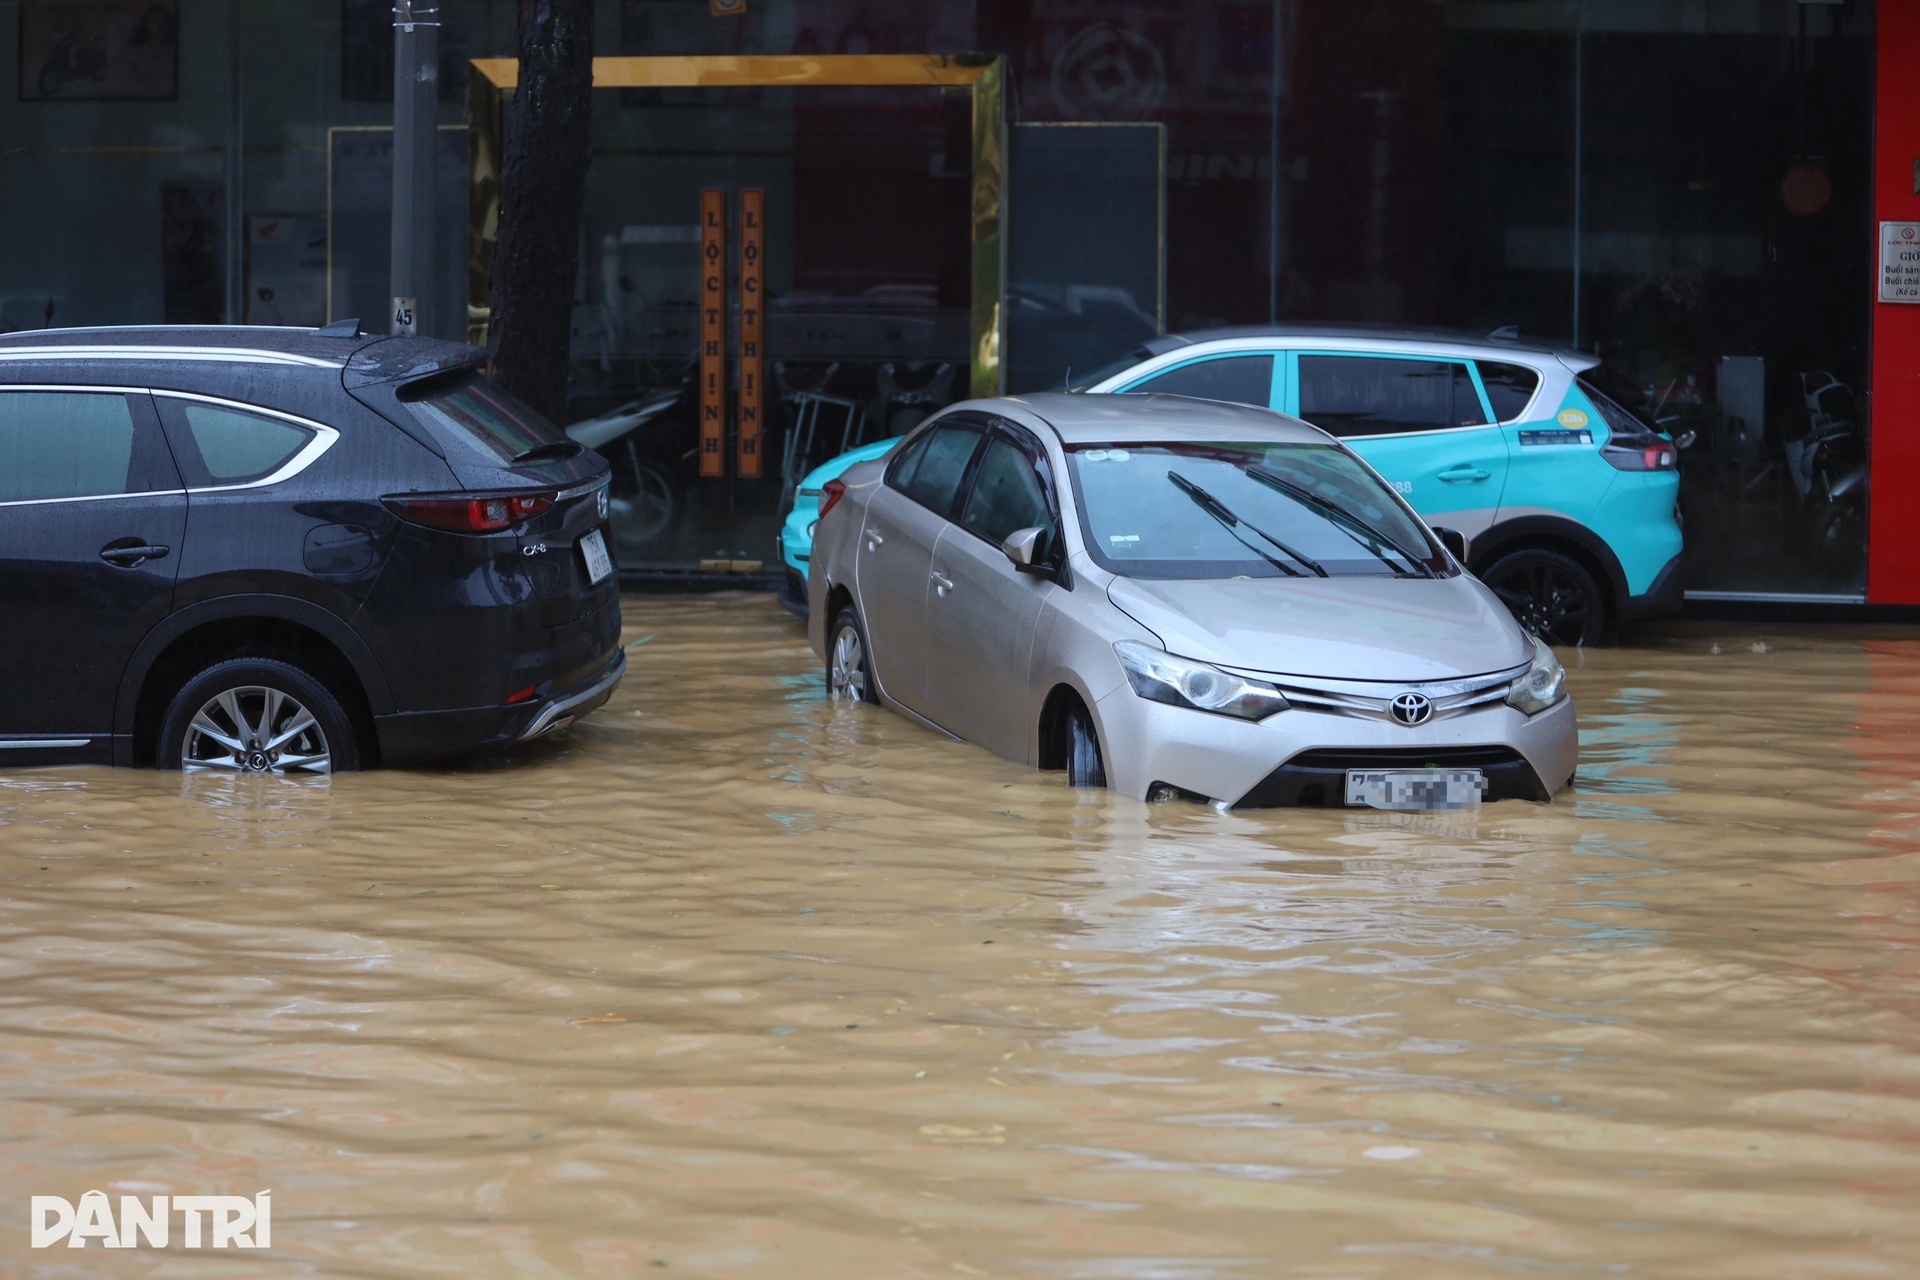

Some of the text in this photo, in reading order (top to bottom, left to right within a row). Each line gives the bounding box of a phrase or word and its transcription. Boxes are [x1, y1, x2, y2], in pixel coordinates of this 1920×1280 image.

[1900, 249, 1920, 261] GIỜ
[1885, 264, 1920, 274] Buổi sán
[1885, 275, 1902, 285] Buổi
[397, 309, 412, 325] 45
[705, 211, 719, 453] LỘC THỊNH
[743, 212, 758, 454] LỘC THỊNH
[1392, 481, 1412, 494] 88
[523, 543, 546, 556] CX-8
